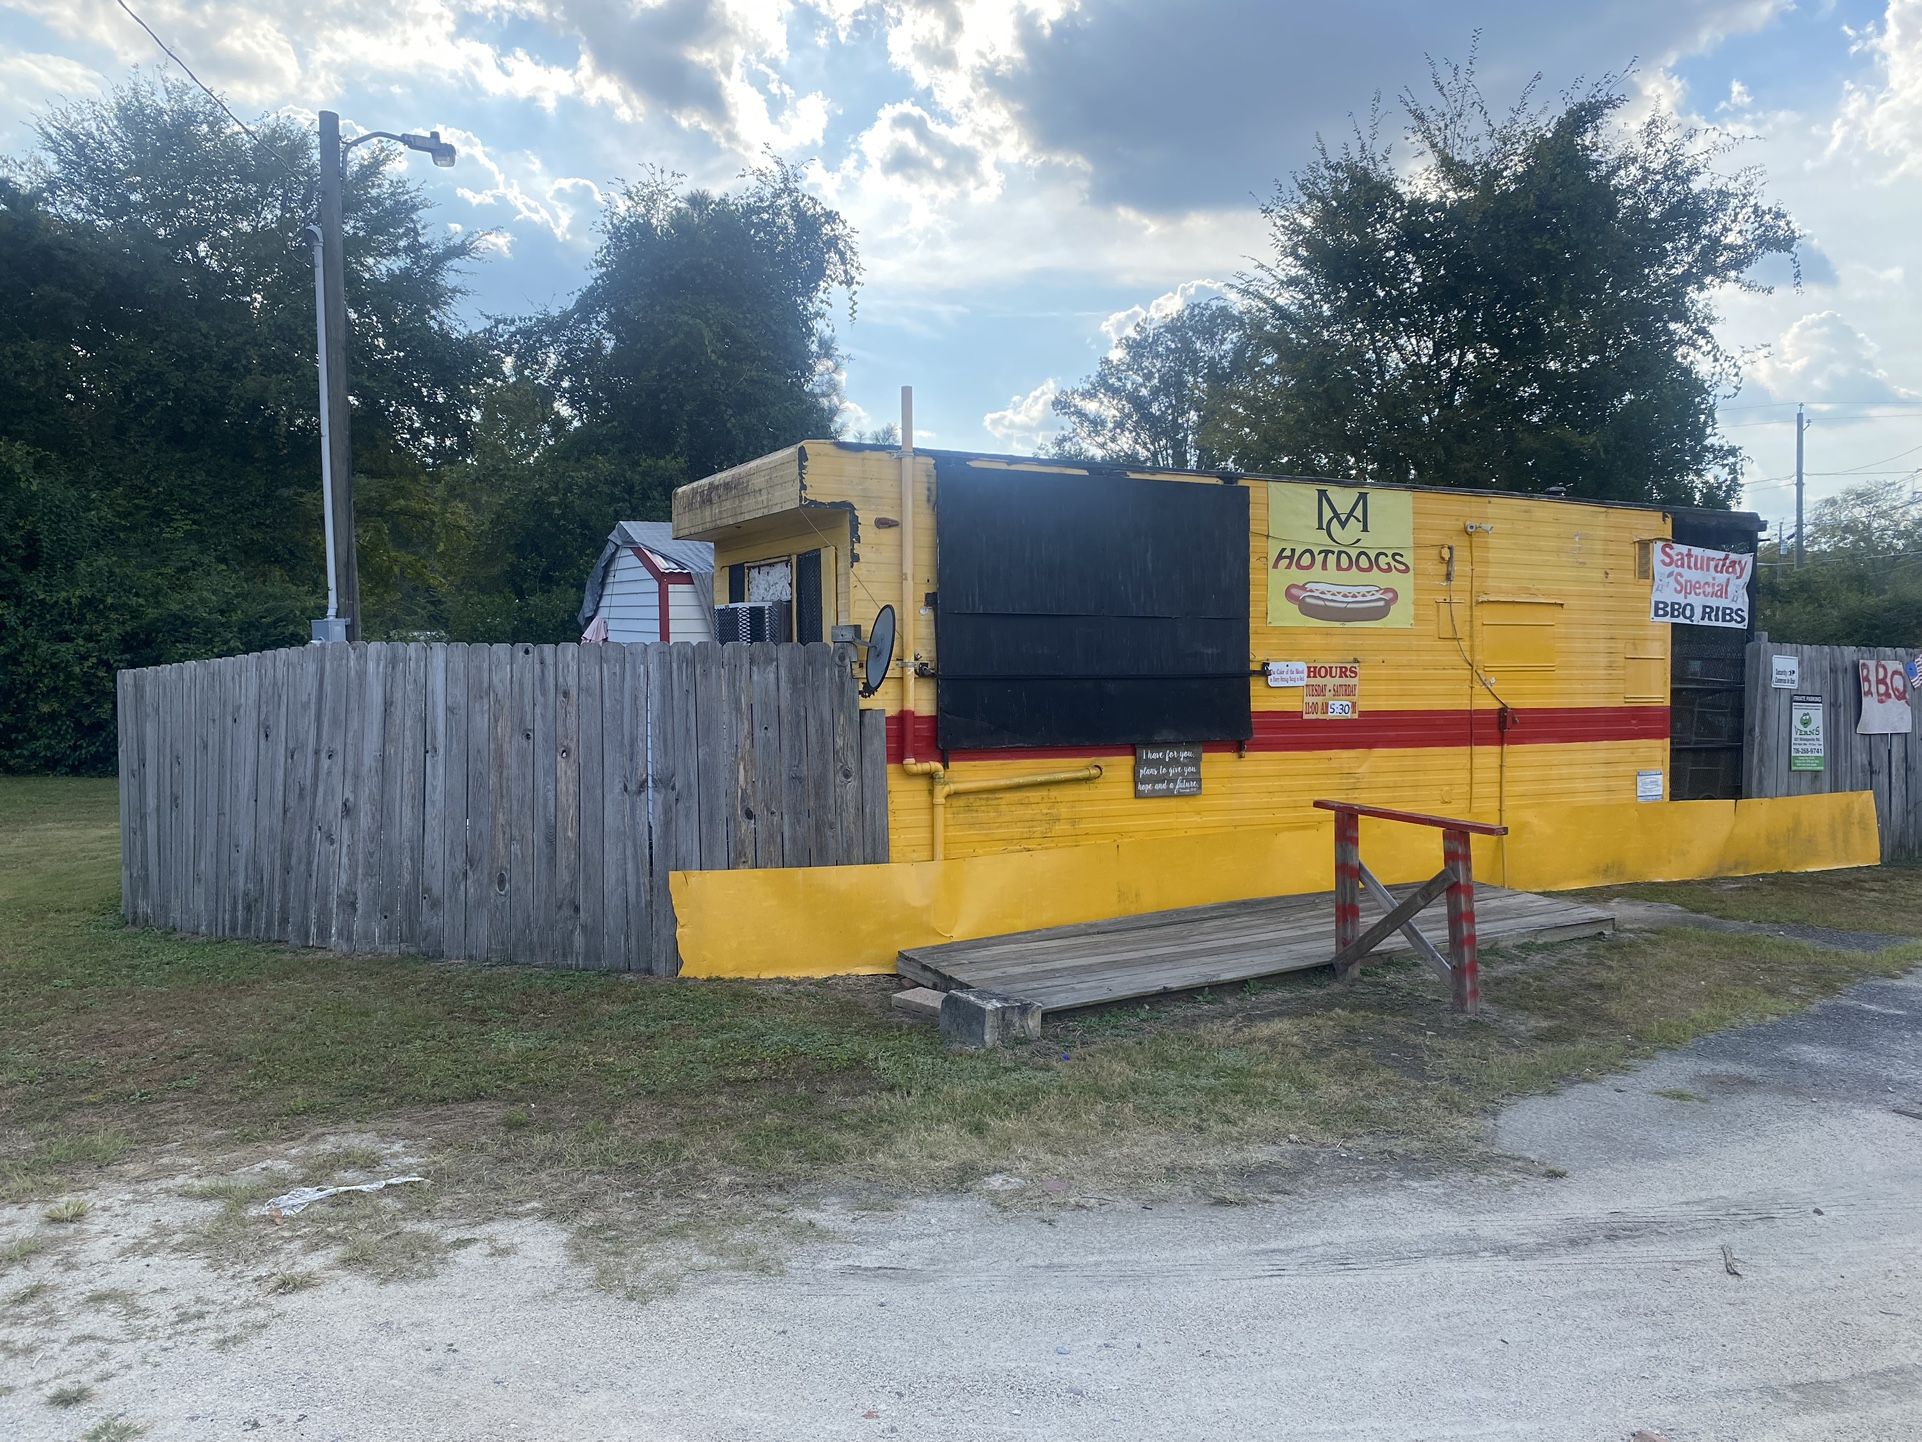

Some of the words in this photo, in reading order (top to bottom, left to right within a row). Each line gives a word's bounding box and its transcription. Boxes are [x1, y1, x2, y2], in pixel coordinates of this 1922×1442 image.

[1271, 547, 1411, 574] HOTDOGS
[1660, 543, 1747, 579] Saturday
[1673, 571, 1731, 599] Special
[1653, 600, 1695, 623] BBQ
[1700, 604, 1747, 624] RIBS
[1306, 665, 1358, 679] HOURS
[1860, 660, 1911, 706] BBQ
[1305, 684, 1328, 697] TUESDAY
[1332, 684, 1358, 697] SATURDAY
[1329, 703, 1351, 715] 5:30
[1147, 749, 1164, 760] have
[1165, 749, 1178, 762] for
[1139, 766, 1158, 779] plans
[1159, 765, 1168, 775] to
[1168, 765, 1183, 777] give
[1183, 765, 1196, 776] you
[1138, 782, 1153, 793] hope
[1154, 780, 1167, 790] and
